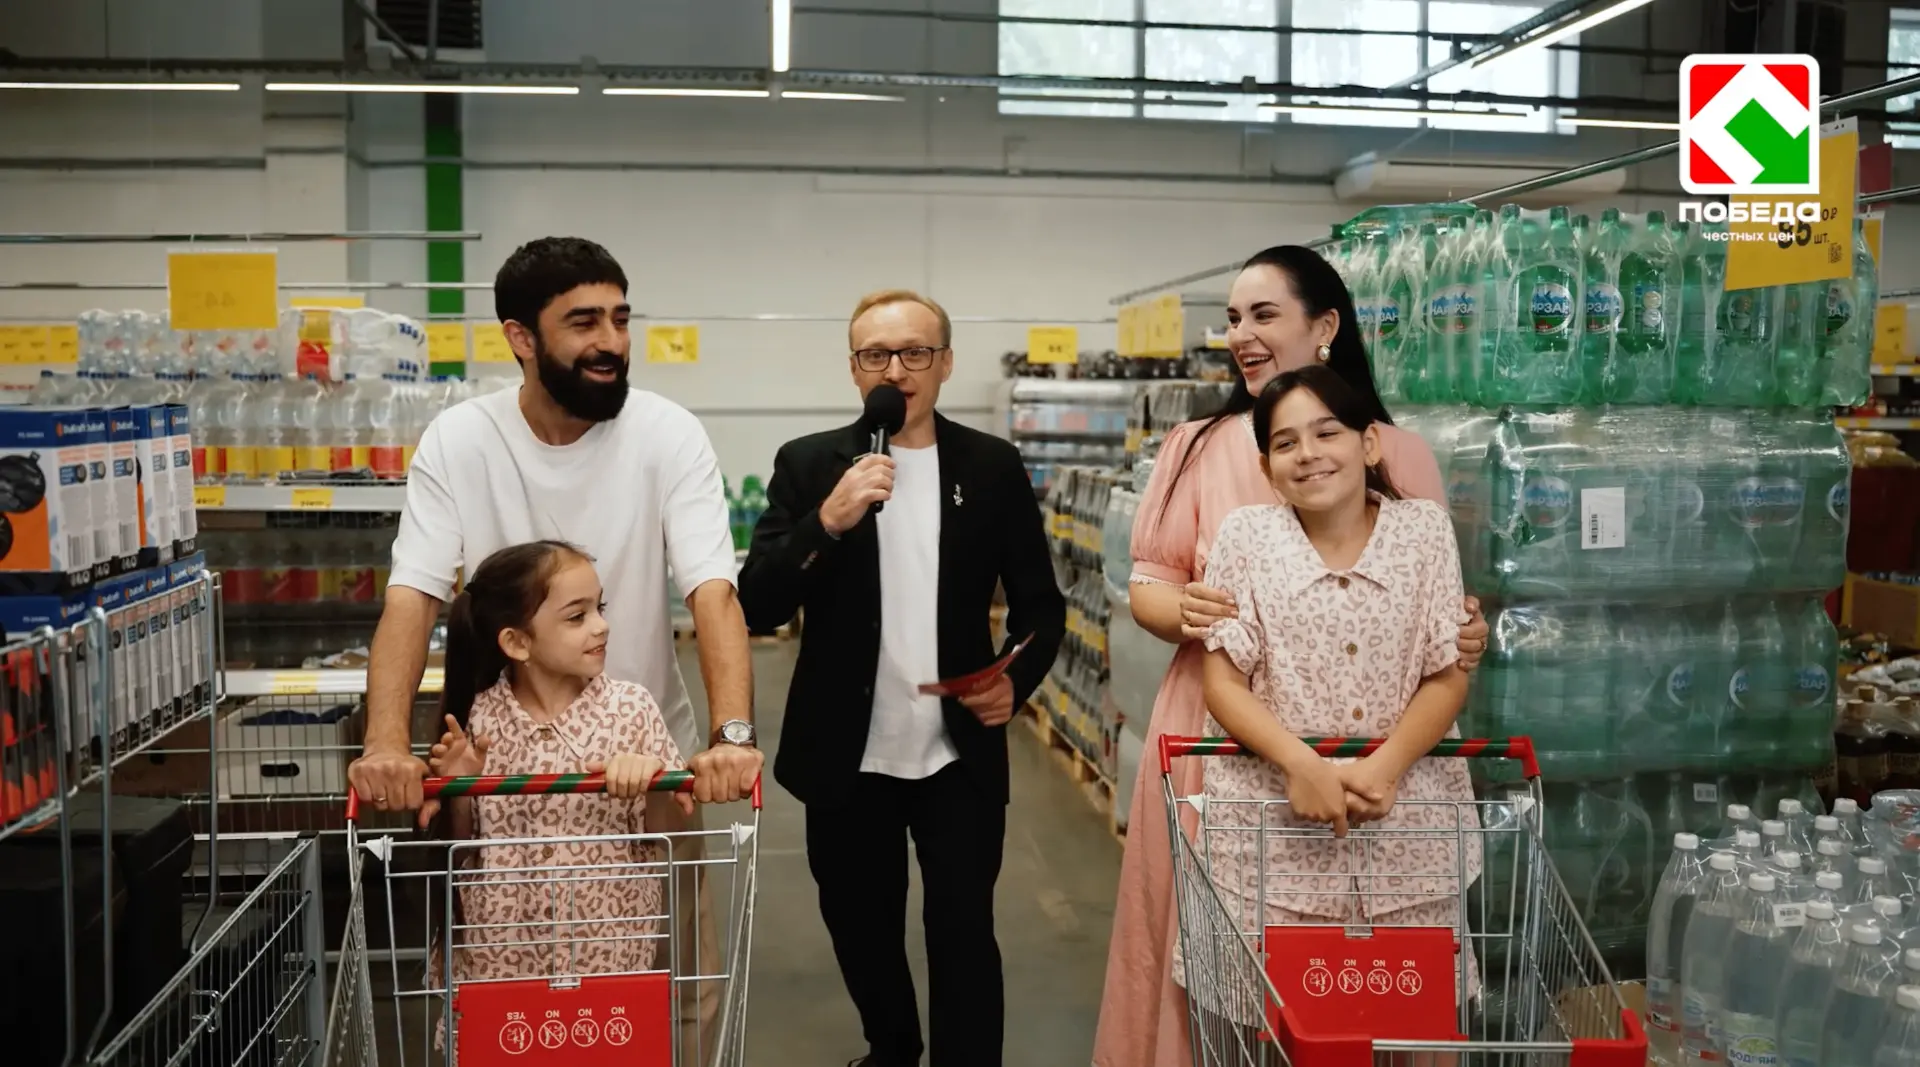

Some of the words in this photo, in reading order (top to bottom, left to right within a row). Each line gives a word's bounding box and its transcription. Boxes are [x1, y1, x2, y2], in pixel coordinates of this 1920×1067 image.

[1309, 958, 1327, 966] YES
[1343, 958, 1357, 967] NO
[1373, 959, 1386, 967] NO
[1402, 959, 1416, 968] NO
[545, 1010, 560, 1019] NO
[578, 1008, 592, 1017] NO
[611, 1006, 625, 1015] NO
[507, 1011, 525, 1020] YES
